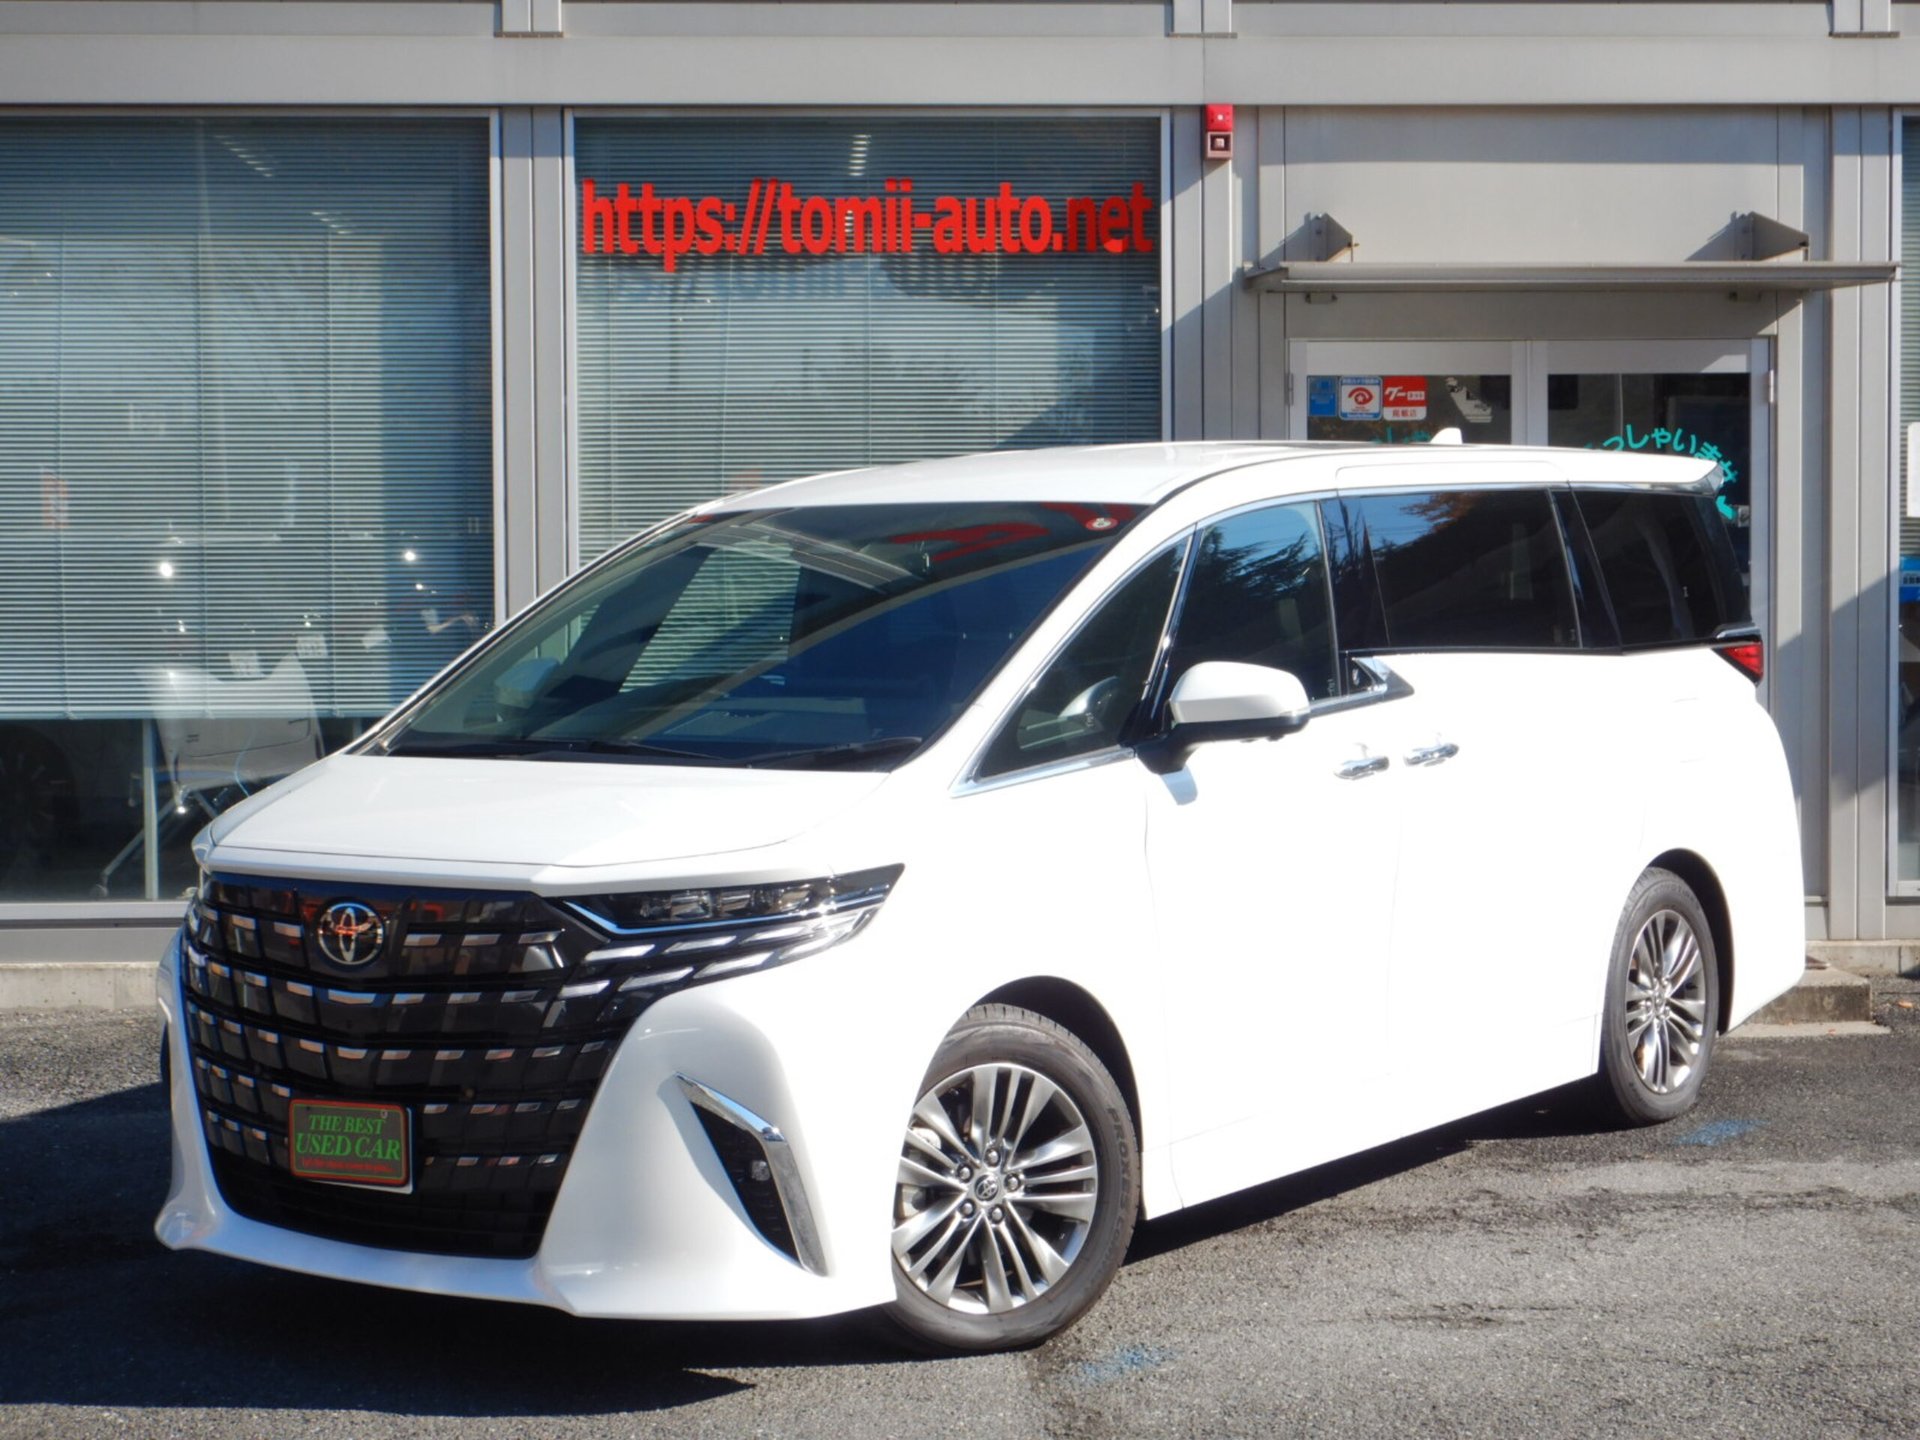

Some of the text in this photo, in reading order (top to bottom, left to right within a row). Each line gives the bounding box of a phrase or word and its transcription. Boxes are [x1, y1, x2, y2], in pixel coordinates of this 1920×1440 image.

[582, 178, 1153, 272] https://tomii-auto.net
[296, 1132, 401, 1160] USED CAR
[309, 1114, 386, 1135] THE BEST
[1107, 1107, 1131, 1210] PROXES
